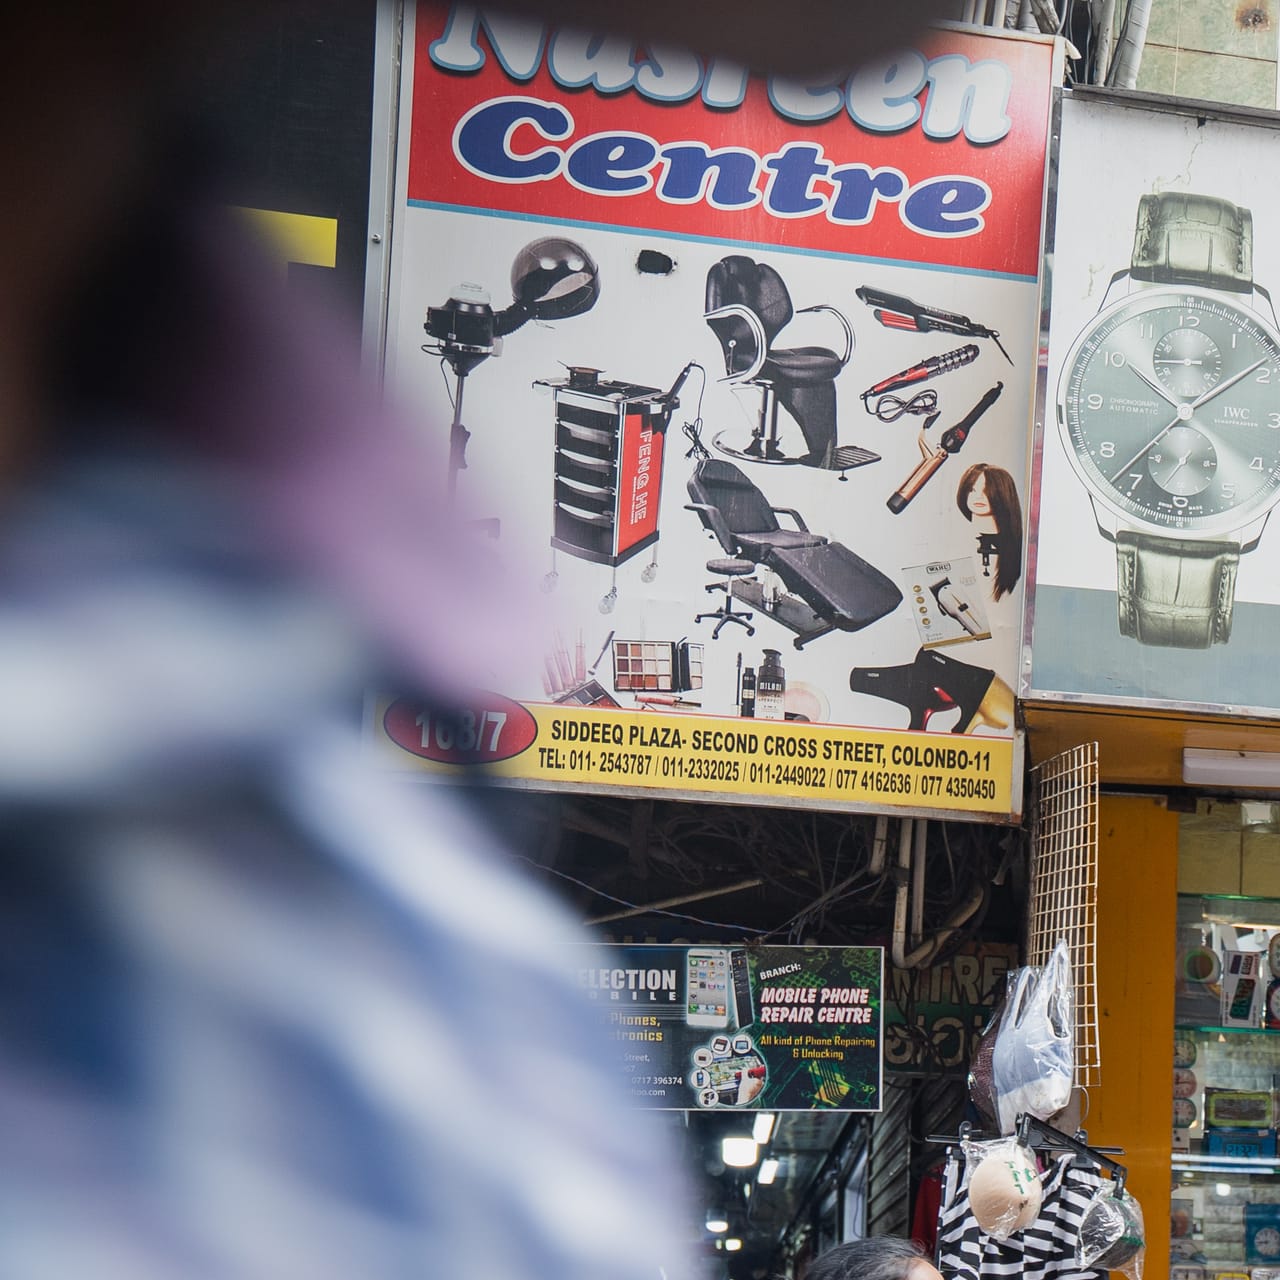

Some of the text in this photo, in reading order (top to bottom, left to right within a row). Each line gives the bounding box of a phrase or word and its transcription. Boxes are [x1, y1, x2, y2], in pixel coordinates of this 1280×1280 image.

[453, 96, 992, 239] Centre
[1109, 405, 1159, 416] AUTOMATIC
[1223, 406, 1249, 420] IWC
[551, 720, 991, 771] SIDDEEQ PLAZA- SECOND CROSS STREET, COLONBO-11
[538, 748, 996, 799] TEL: 011- 2543787 011-2332025 011-2449022 077 4162636 077 4350450
[760, 963, 802, 980] BRANCH:
[760, 988, 869, 1004] MOBILE PHONE
[760, 1007, 872, 1023] REPAIR CENTRE
[760, 1035, 876, 1048] All kind of Phone Repairing
[801, 1049, 844, 1060] Unlocking
[653, 1077, 682, 1085] 396374
